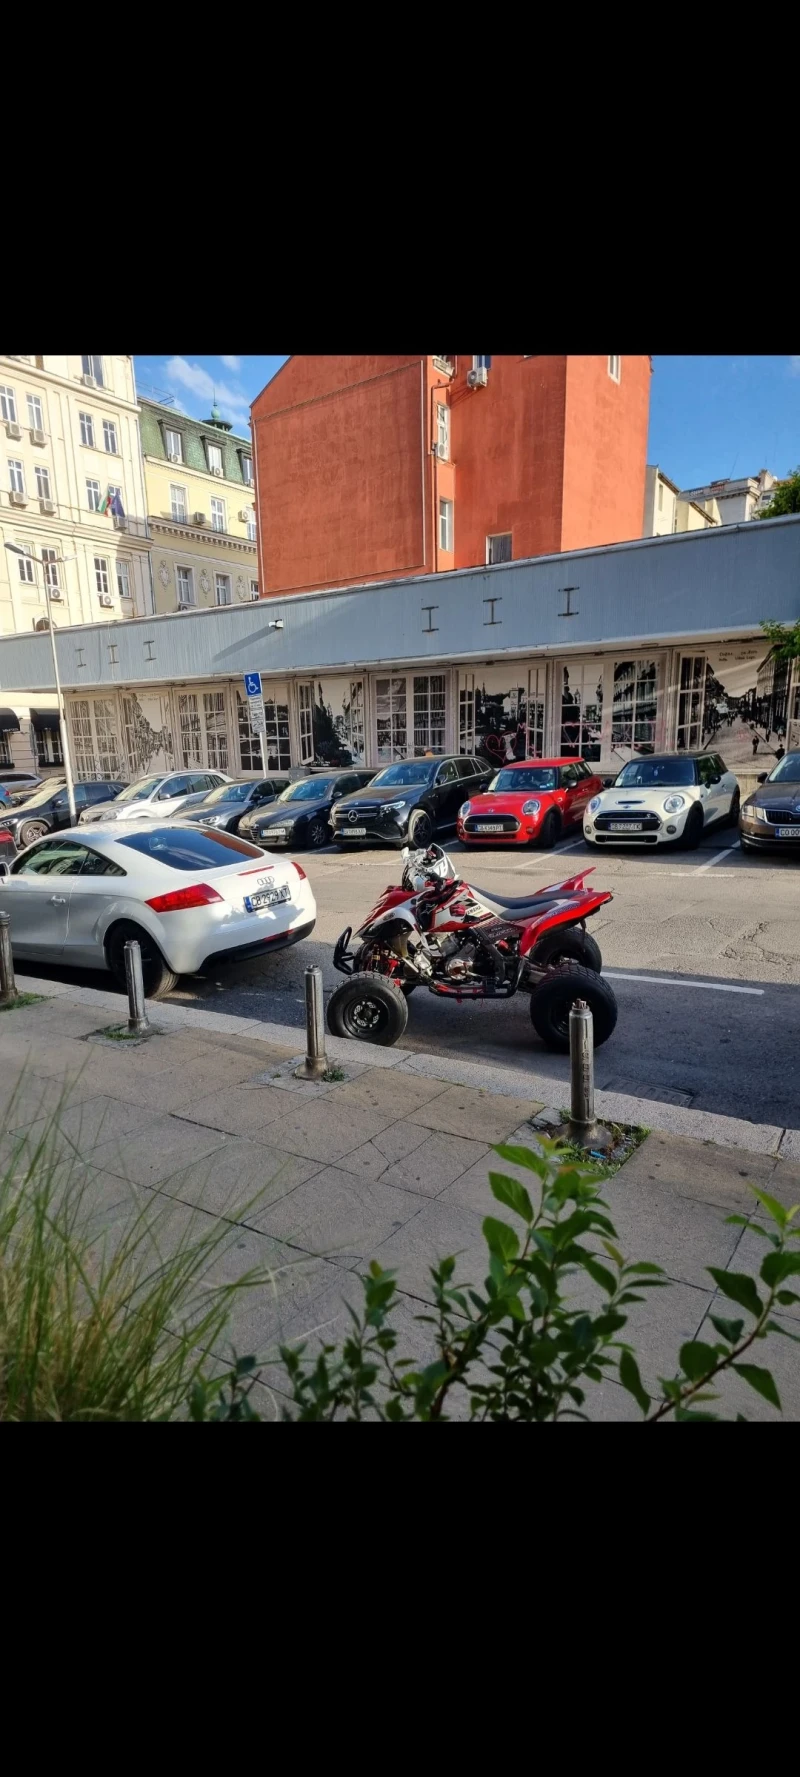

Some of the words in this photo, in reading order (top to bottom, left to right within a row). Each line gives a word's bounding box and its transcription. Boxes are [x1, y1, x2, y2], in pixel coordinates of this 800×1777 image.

[251, 895, 262, 907] CB
[262, 890, 279, 904] 2929
[279, 888, 288, 898] XT
